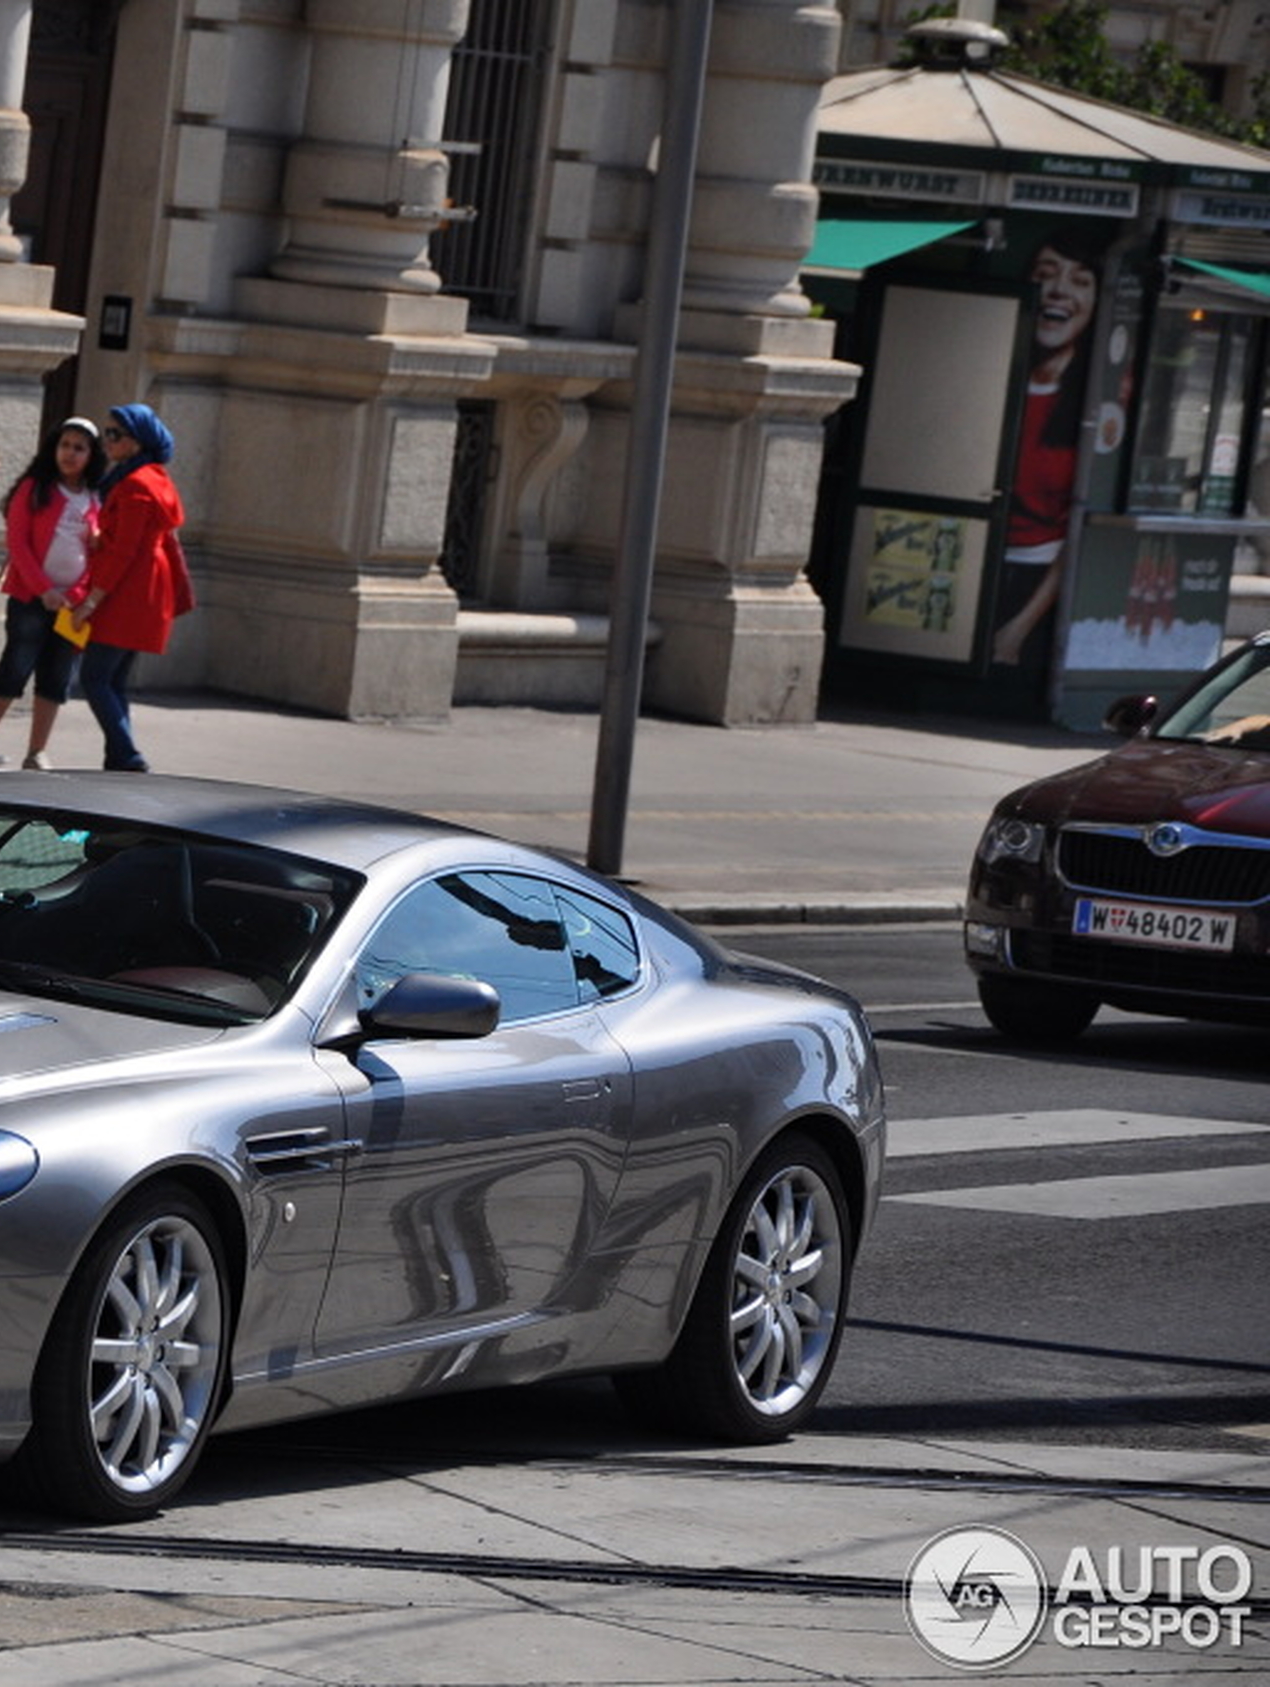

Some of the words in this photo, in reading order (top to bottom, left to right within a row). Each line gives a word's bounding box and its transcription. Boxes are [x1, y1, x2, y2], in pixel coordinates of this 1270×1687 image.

[1093, 906, 1109, 931] W
[1126, 910, 1203, 942] 48402
[1211, 917, 1229, 944] W
